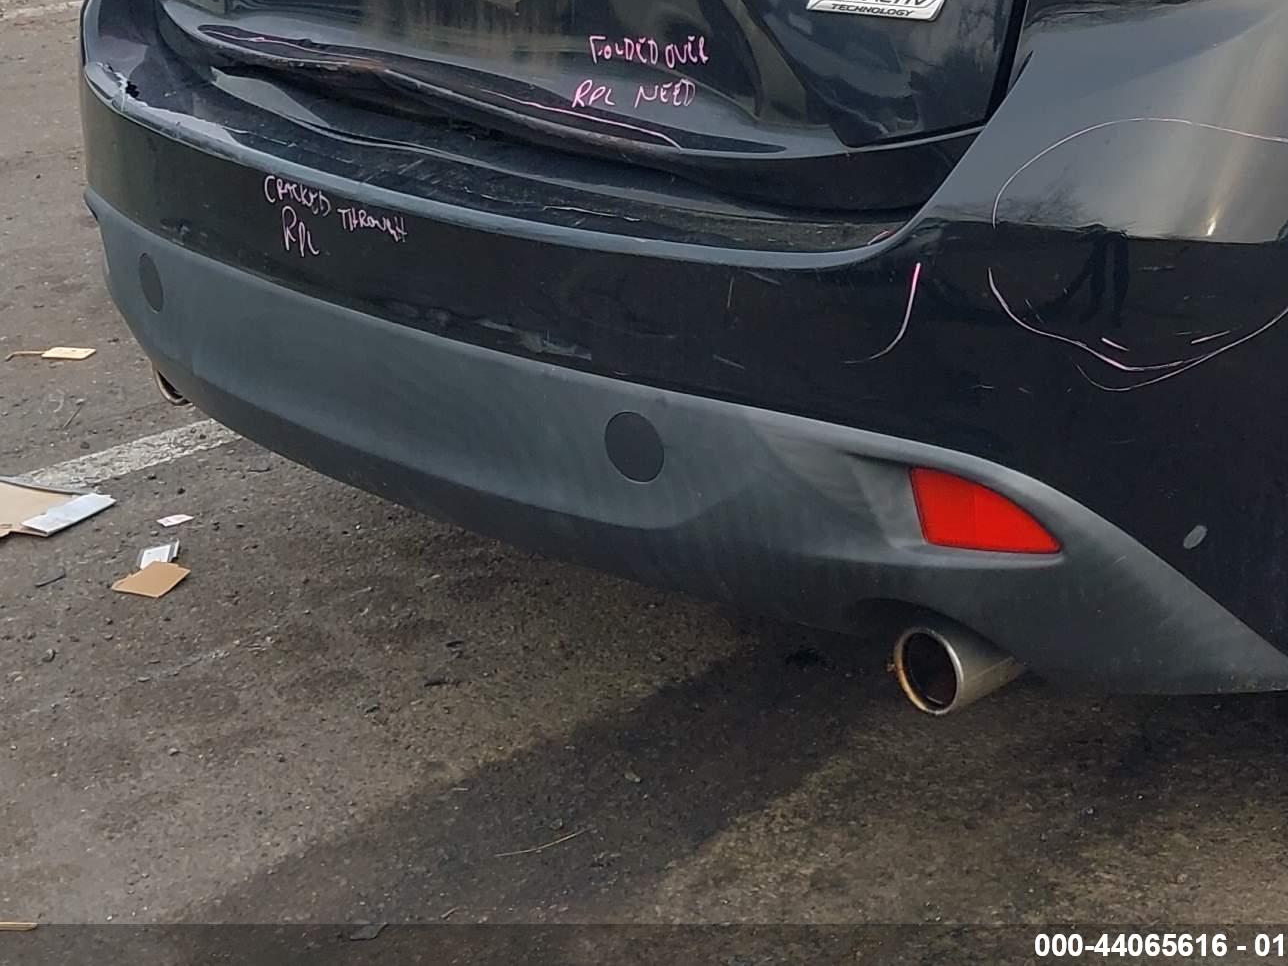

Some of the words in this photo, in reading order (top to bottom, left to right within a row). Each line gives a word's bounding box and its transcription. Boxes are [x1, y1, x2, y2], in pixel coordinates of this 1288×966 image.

[830, 2, 915, 17] TECHNOLOGY
[571, 79, 616, 108] RPL
[634, 78, 696, 108] NEED
